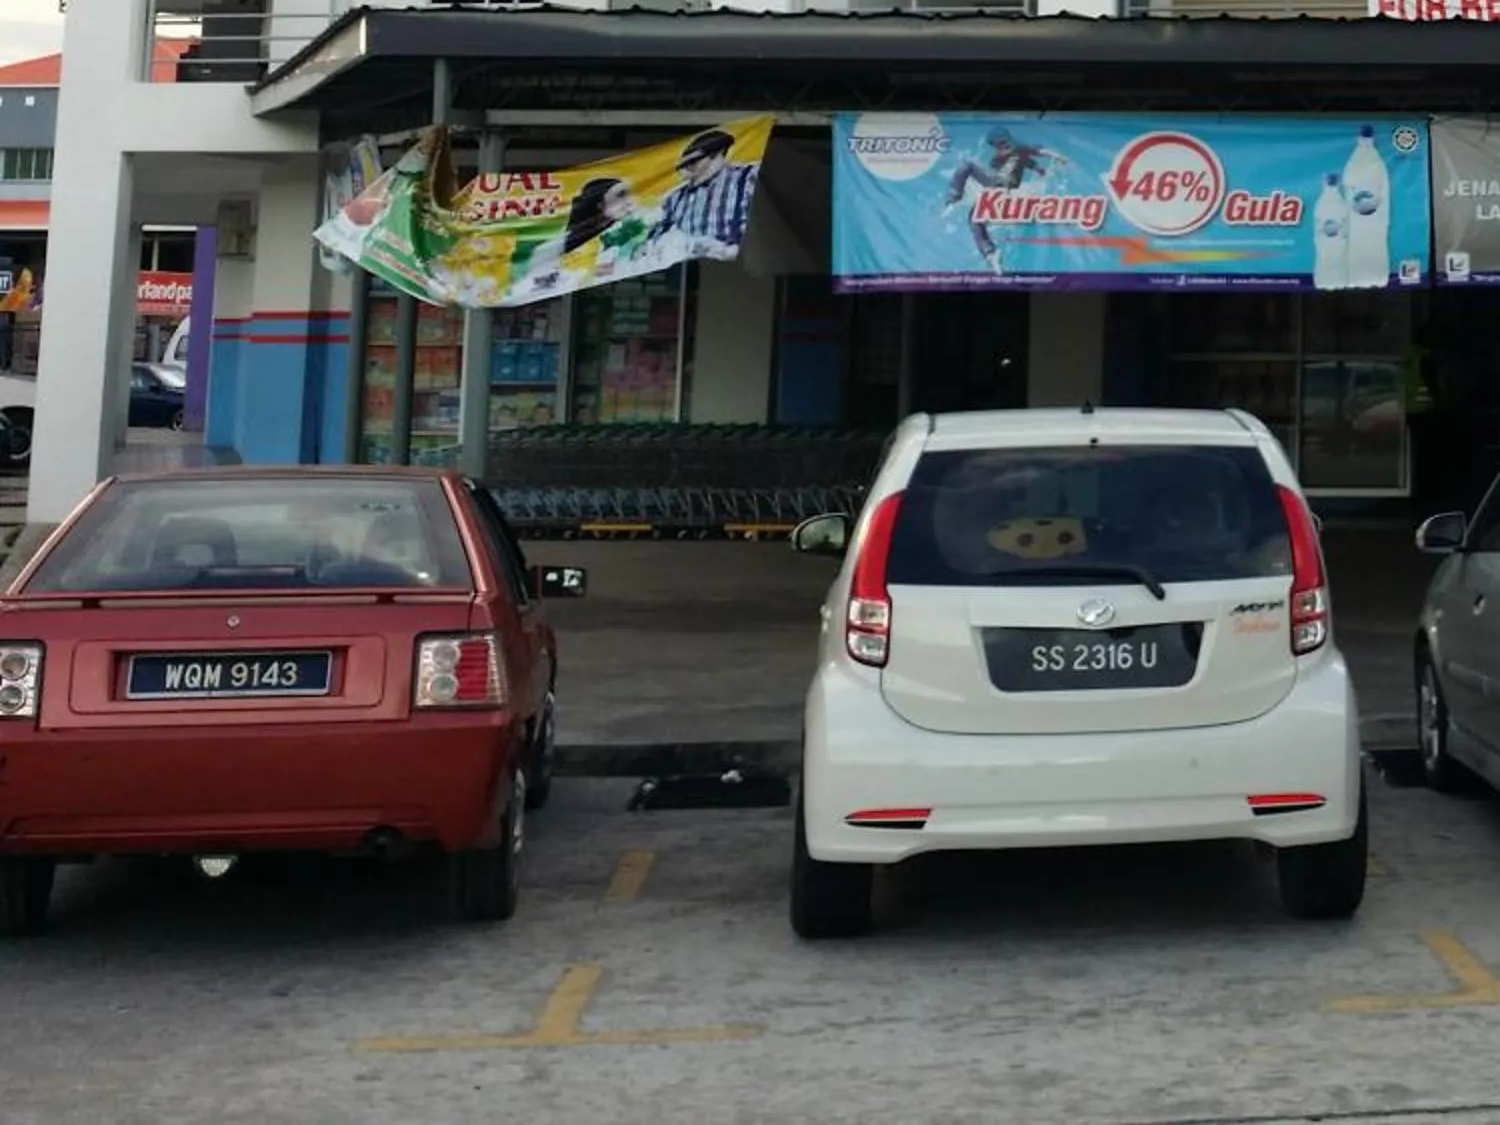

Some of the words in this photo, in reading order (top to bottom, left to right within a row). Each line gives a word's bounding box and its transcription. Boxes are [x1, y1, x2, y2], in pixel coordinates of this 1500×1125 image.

[972, 190, 1105, 229] Kurang
[1132, 169, 1211, 203] 46%
[1224, 190, 1302, 225] Gula
[1032, 645, 1065, 672] SS
[1073, 643, 1133, 671] 2316
[1140, 642, 1157, 669] U
[164, 663, 221, 689] WQM
[231, 662, 298, 688] 9143
